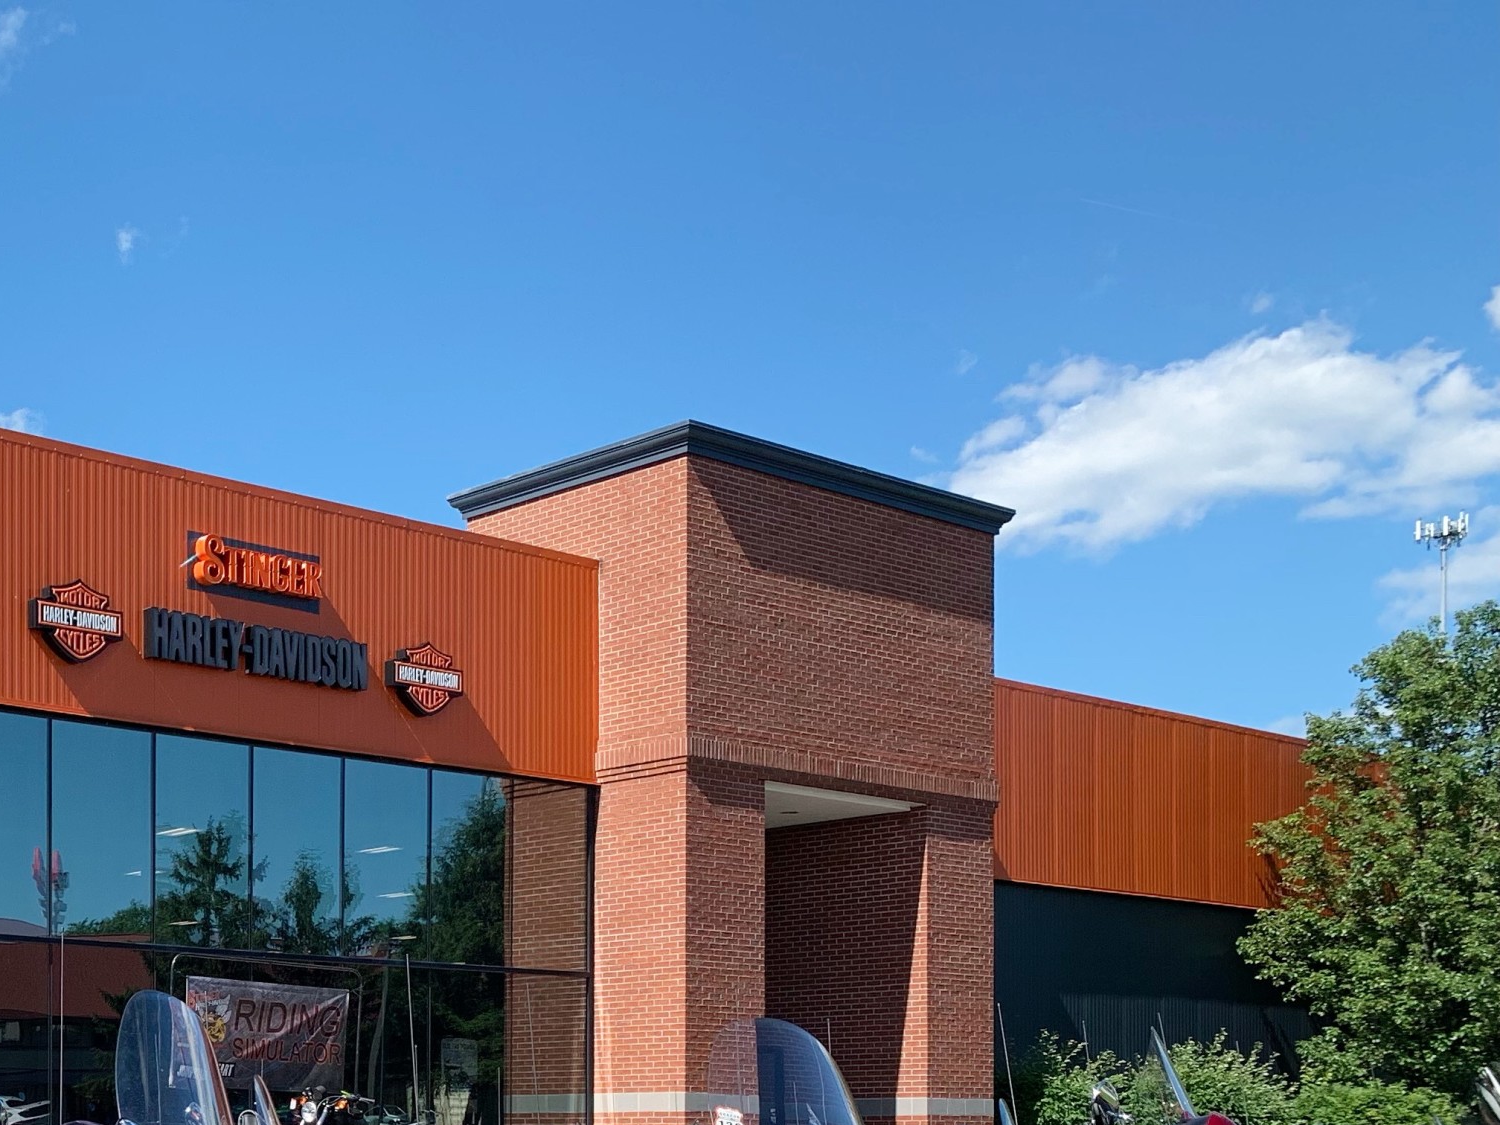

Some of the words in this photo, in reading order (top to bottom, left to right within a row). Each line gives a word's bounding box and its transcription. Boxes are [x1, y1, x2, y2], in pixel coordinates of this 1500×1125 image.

[193, 532, 324, 598] STINGER
[60, 589, 101, 609] MOTOR
[43, 605, 117, 633] HARLEY-DAVIDSON
[60, 629, 101, 654] CYCLES
[145, 607, 368, 691] HARLEY-DAVIDSON
[412, 649, 445, 668] MOTOR
[399, 665, 459, 689] HARLEY-DAVIDSON
[412, 686, 445, 708] CYCLES
[233, 999, 342, 1038] RIDING
[231, 1037, 342, 1065] SIMULATOR
